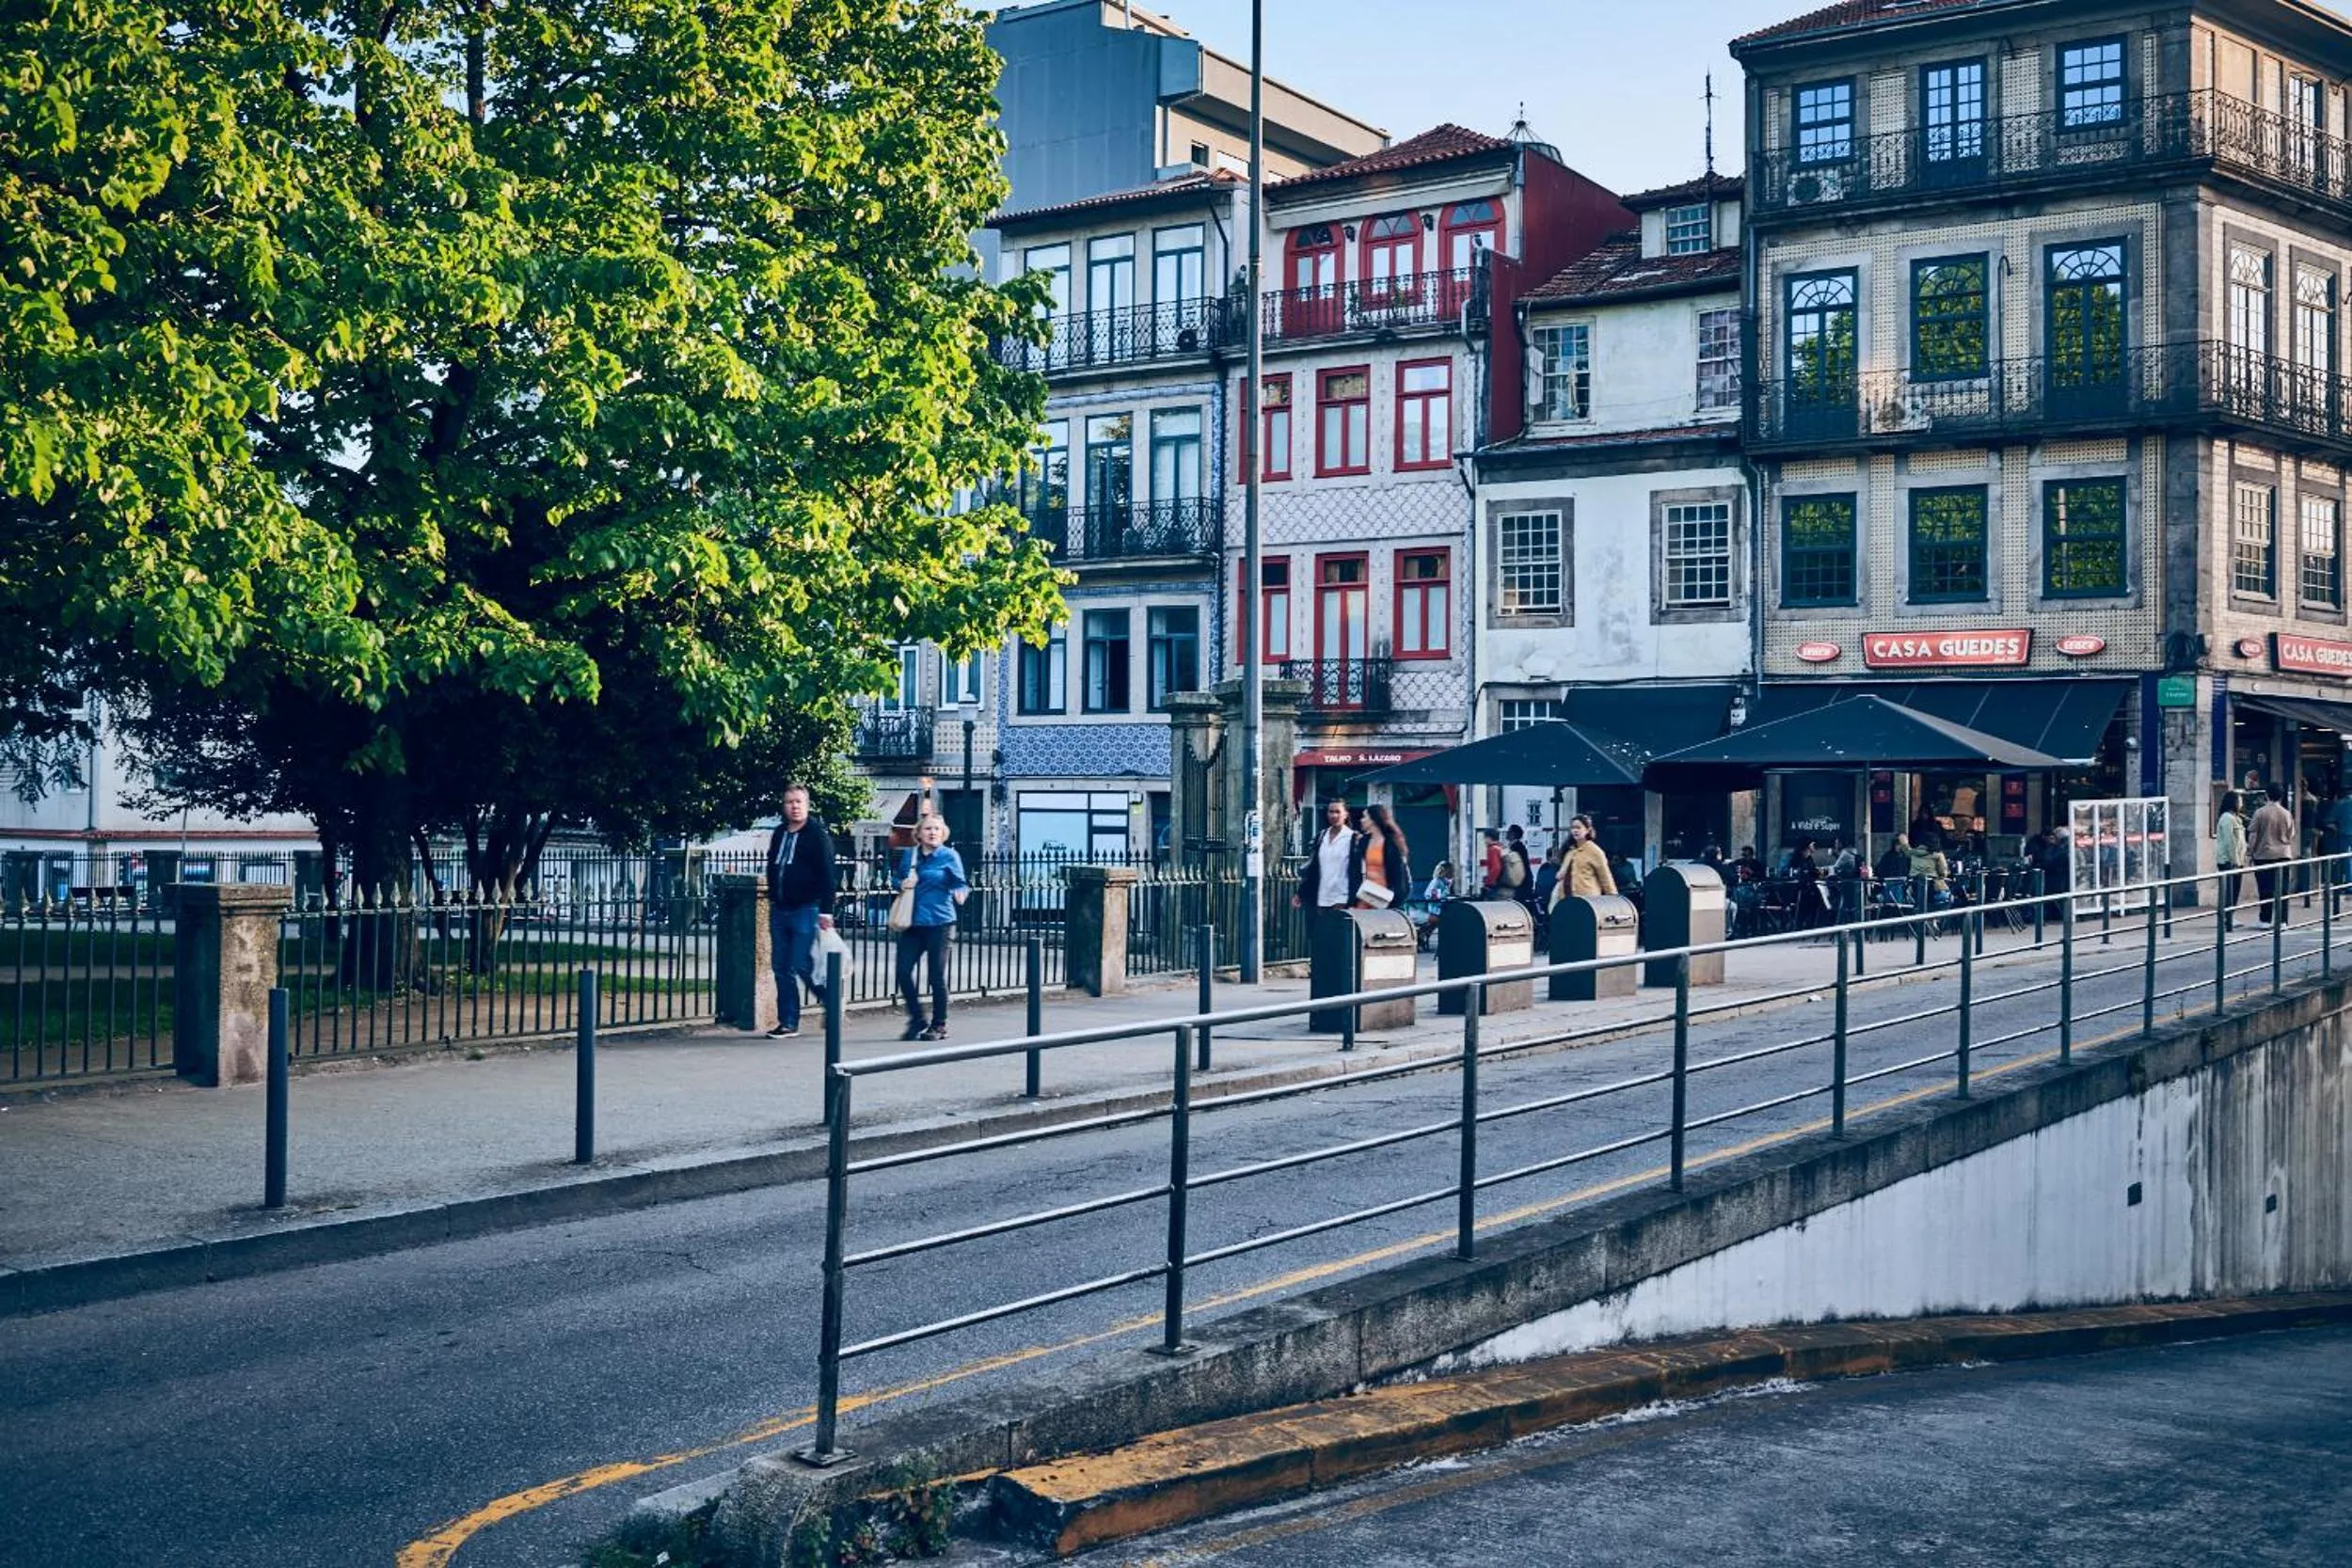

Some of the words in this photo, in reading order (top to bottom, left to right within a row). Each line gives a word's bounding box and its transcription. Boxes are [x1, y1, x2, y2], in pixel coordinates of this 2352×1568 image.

[1873, 640, 1932, 657] CASA
[1939, 638, 2020, 657] GUEDES
[2282, 643, 2313, 662] CASA
